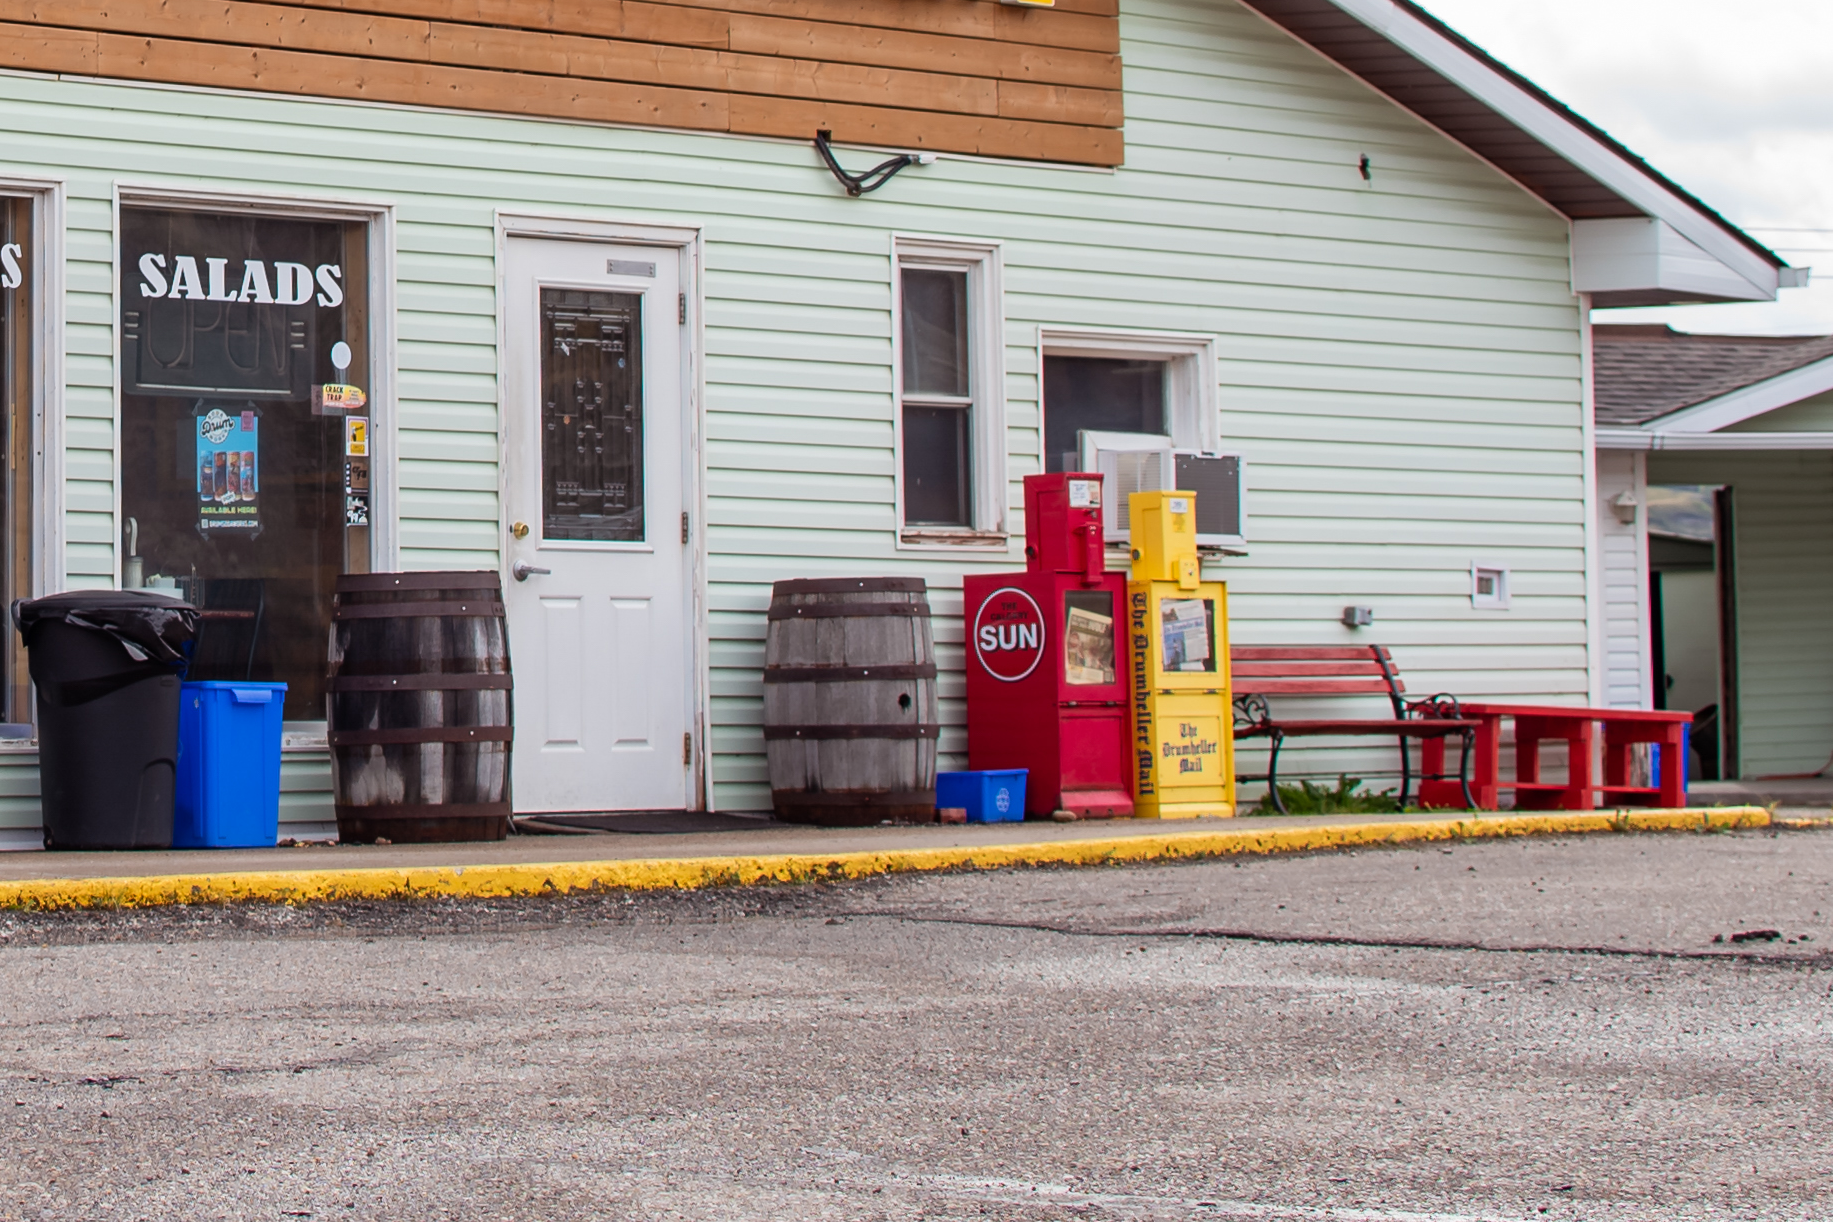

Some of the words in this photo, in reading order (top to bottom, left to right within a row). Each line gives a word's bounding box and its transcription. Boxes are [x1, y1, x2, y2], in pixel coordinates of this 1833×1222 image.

[138, 253, 344, 308] SALADS
[325, 385, 344, 394] CRACK
[326, 393, 342, 402] TRAP
[201, 418, 234, 436] Drum
[1131, 592, 1147, 629] The
[980, 623, 1038, 651] SUN
[1133, 634, 1153, 745] Drumheller
[1179, 722, 1197, 738] The
[1137, 748, 1155, 797] Mail
[1179, 757, 1202, 774] Mail
